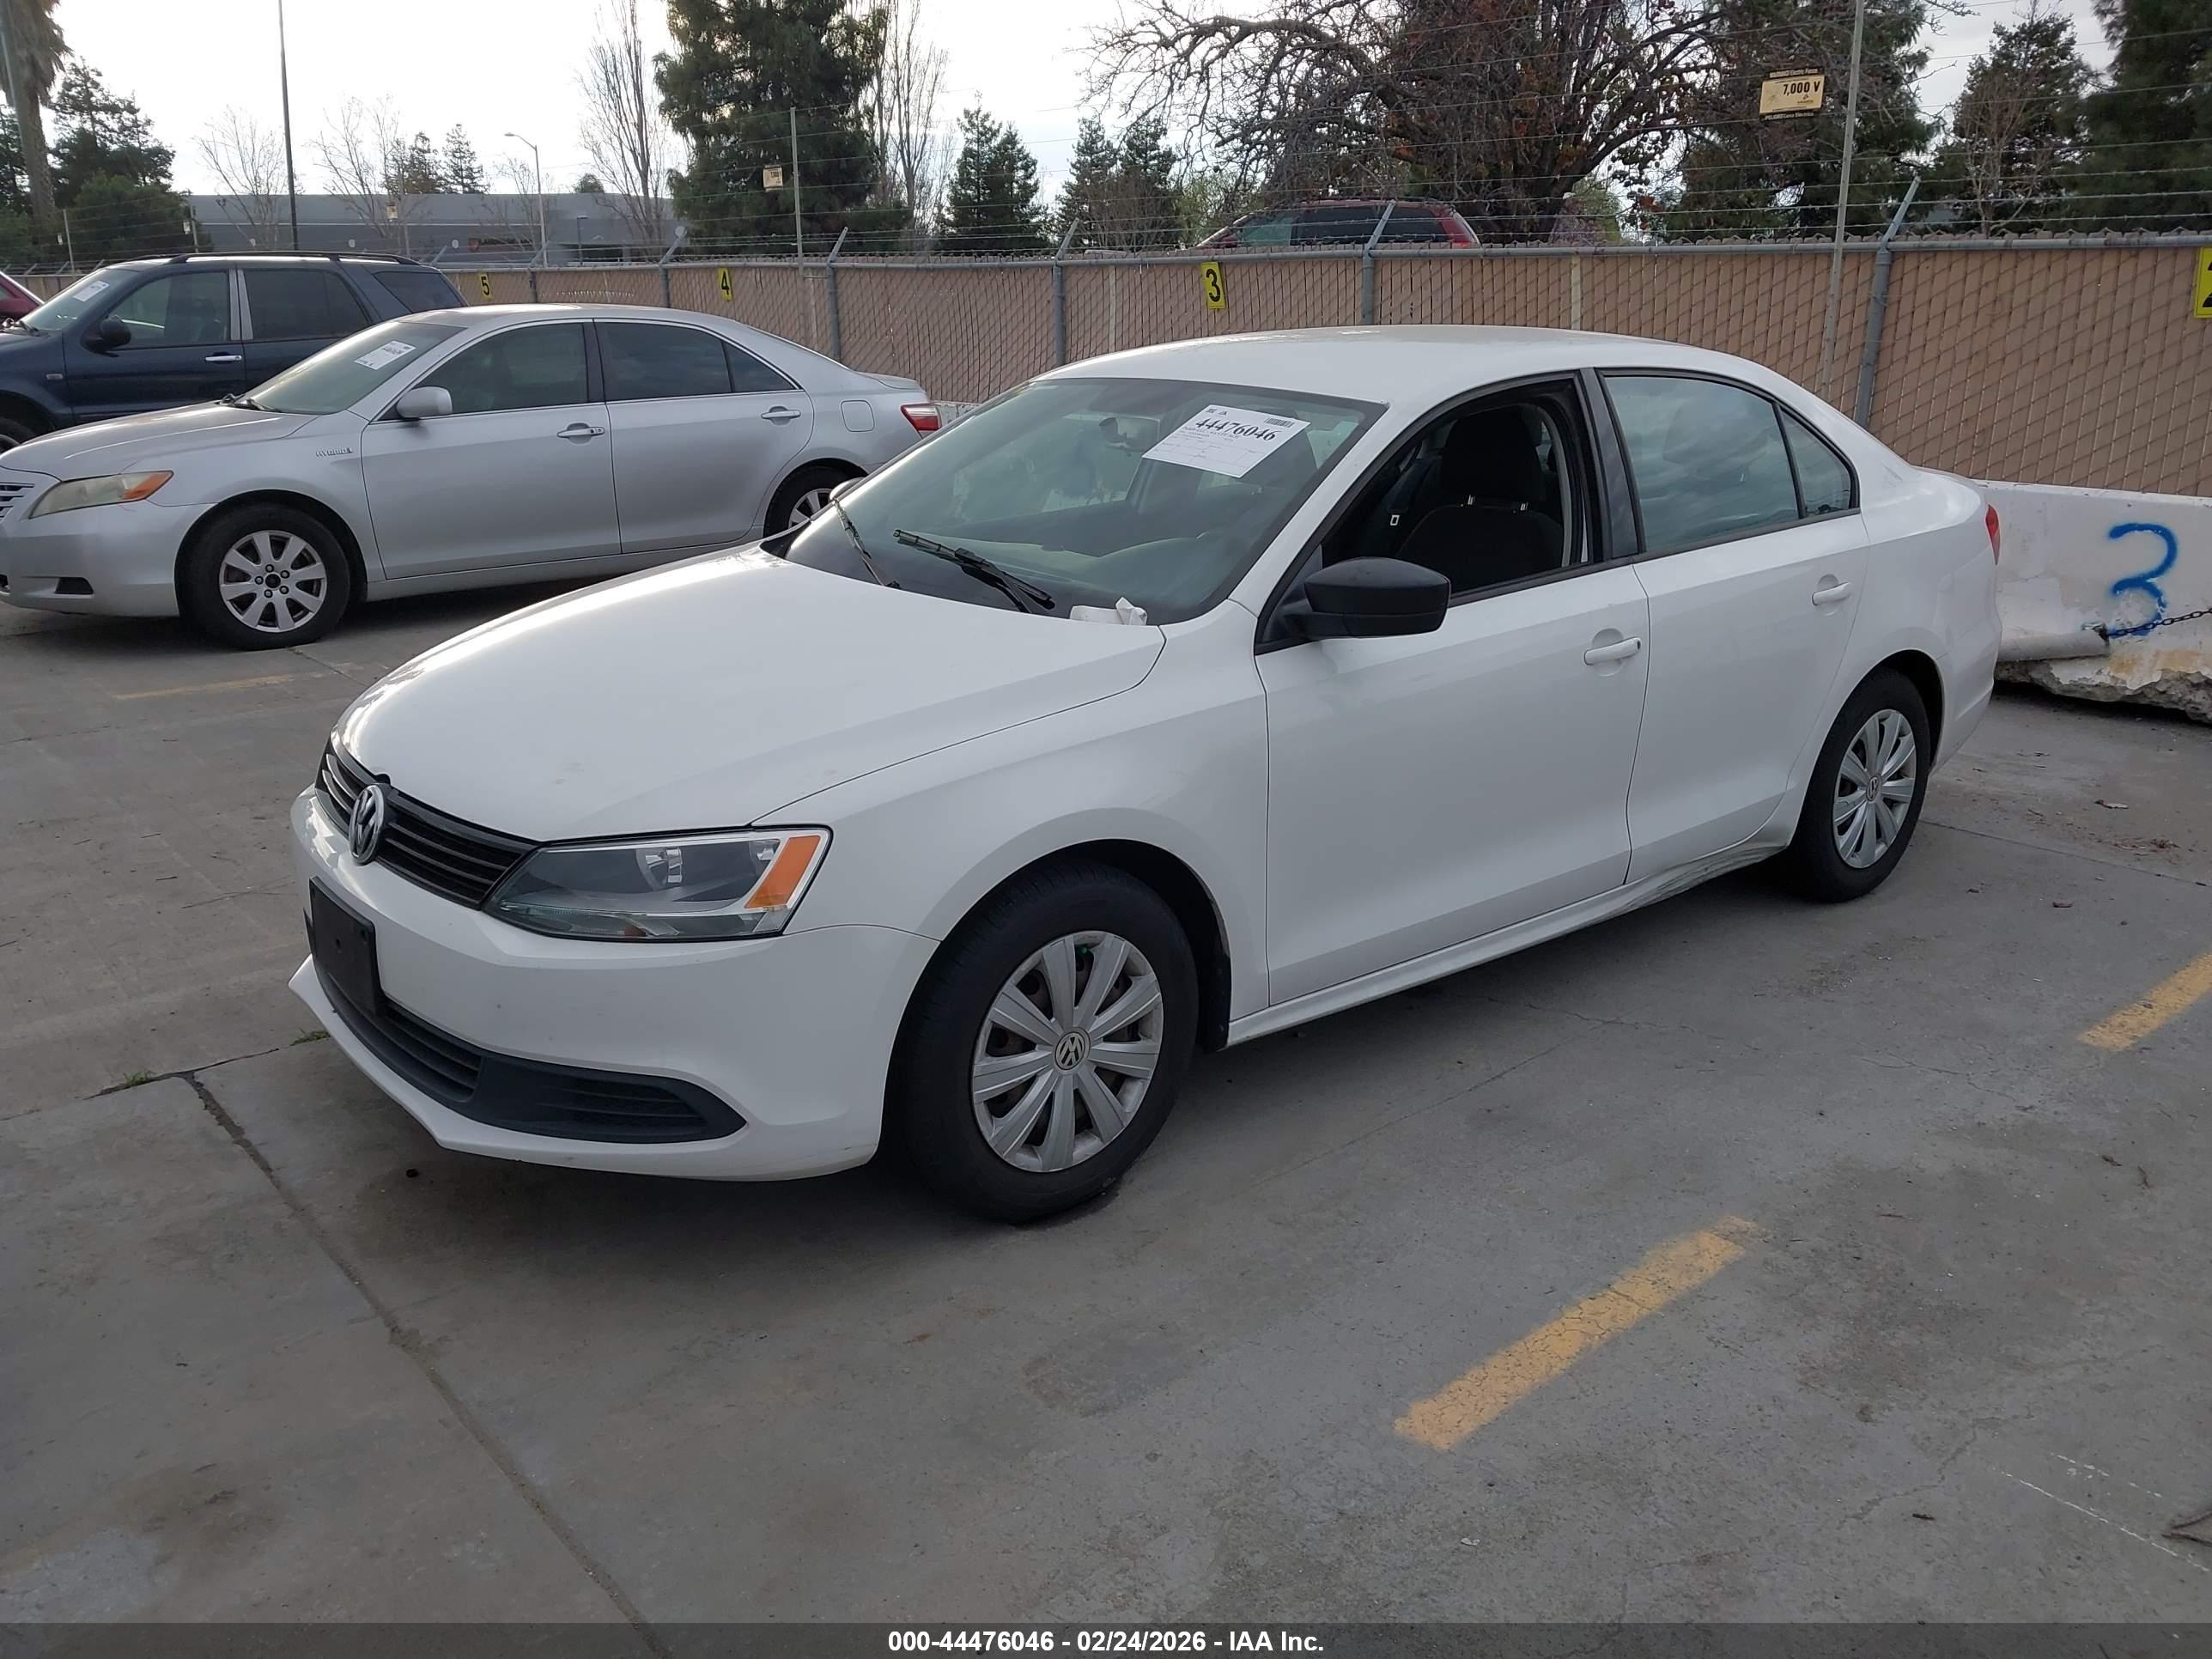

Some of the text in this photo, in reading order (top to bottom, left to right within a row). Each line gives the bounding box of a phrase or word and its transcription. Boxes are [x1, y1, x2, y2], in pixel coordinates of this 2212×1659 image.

[1783, 82, 1810, 96] 7,000
[1814, 81, 1820, 92] V
[481, 276, 489, 296] 5
[721, 270, 729, 295] 4
[1206, 268, 1221, 302] 3
[1195, 418, 1281, 441] 44476046
[2109, 523, 2178, 639] 3
